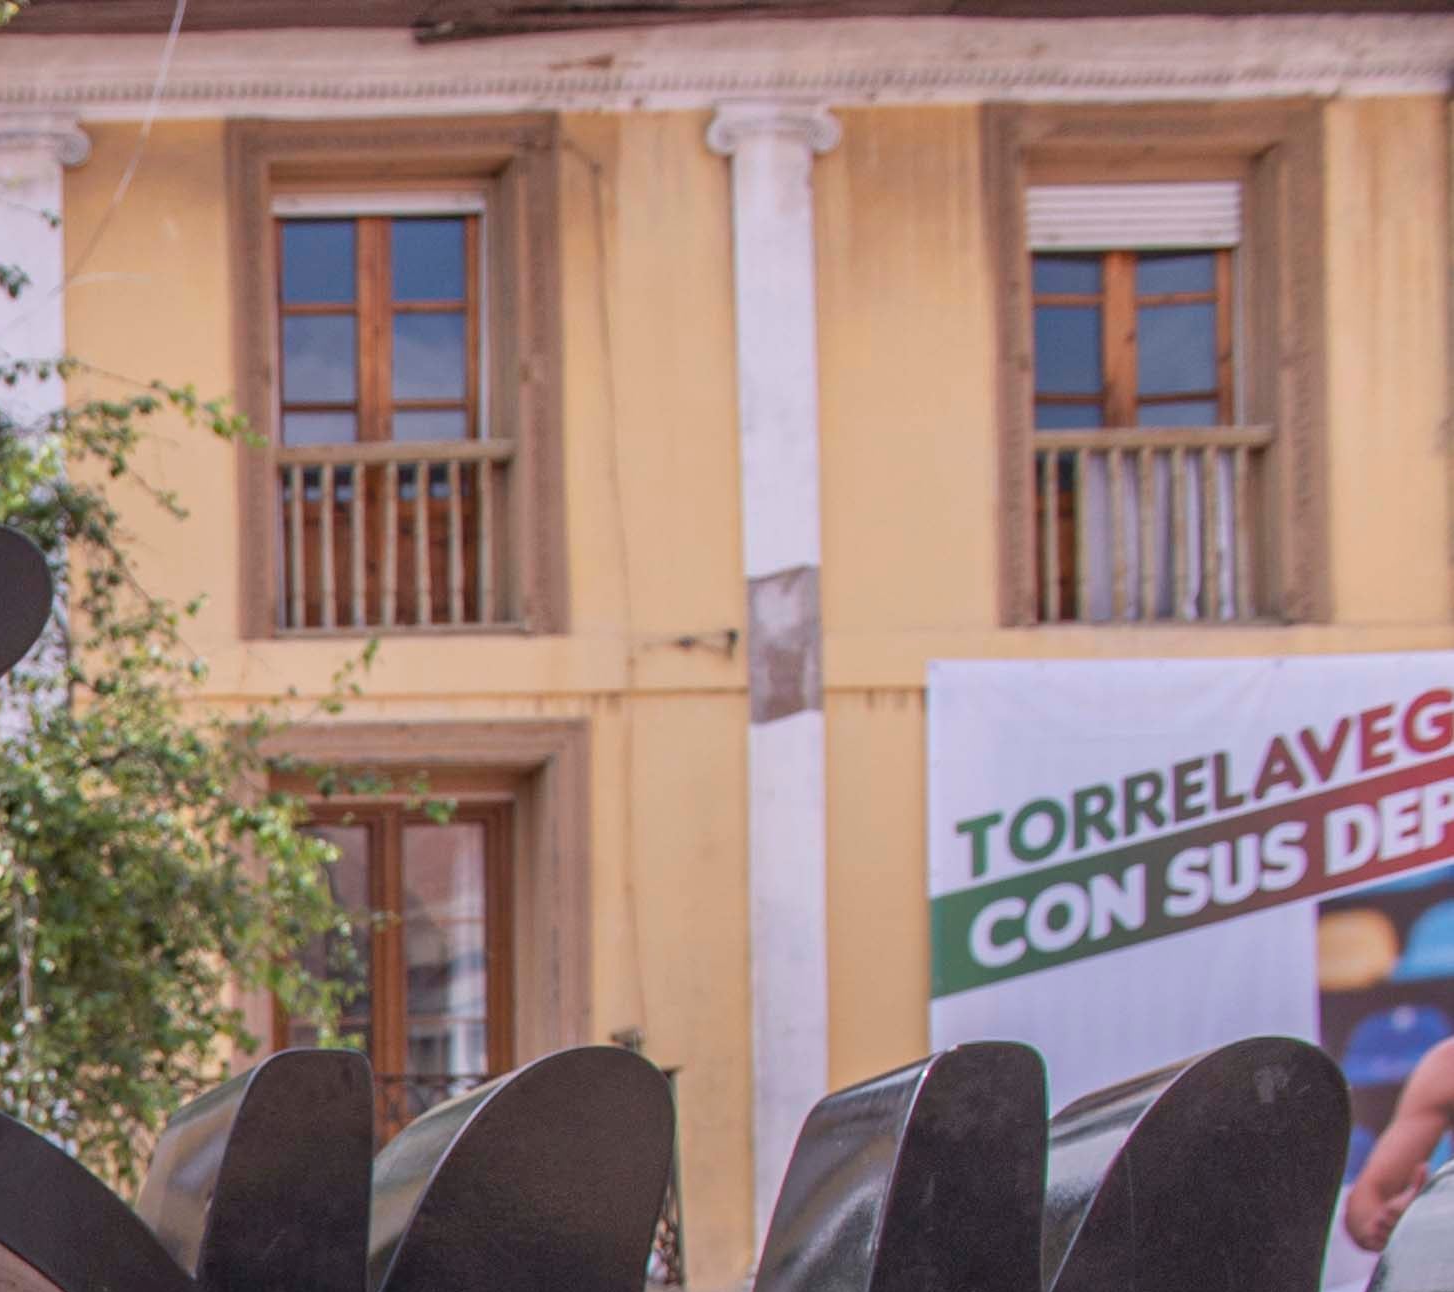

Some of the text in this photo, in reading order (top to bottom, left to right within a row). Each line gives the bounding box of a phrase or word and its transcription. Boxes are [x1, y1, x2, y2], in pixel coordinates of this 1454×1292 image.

[954, 686, 1454, 879] TORRELAVEG
[967, 863, 1147, 970] CON
[1161, 820, 1309, 919] SUS
